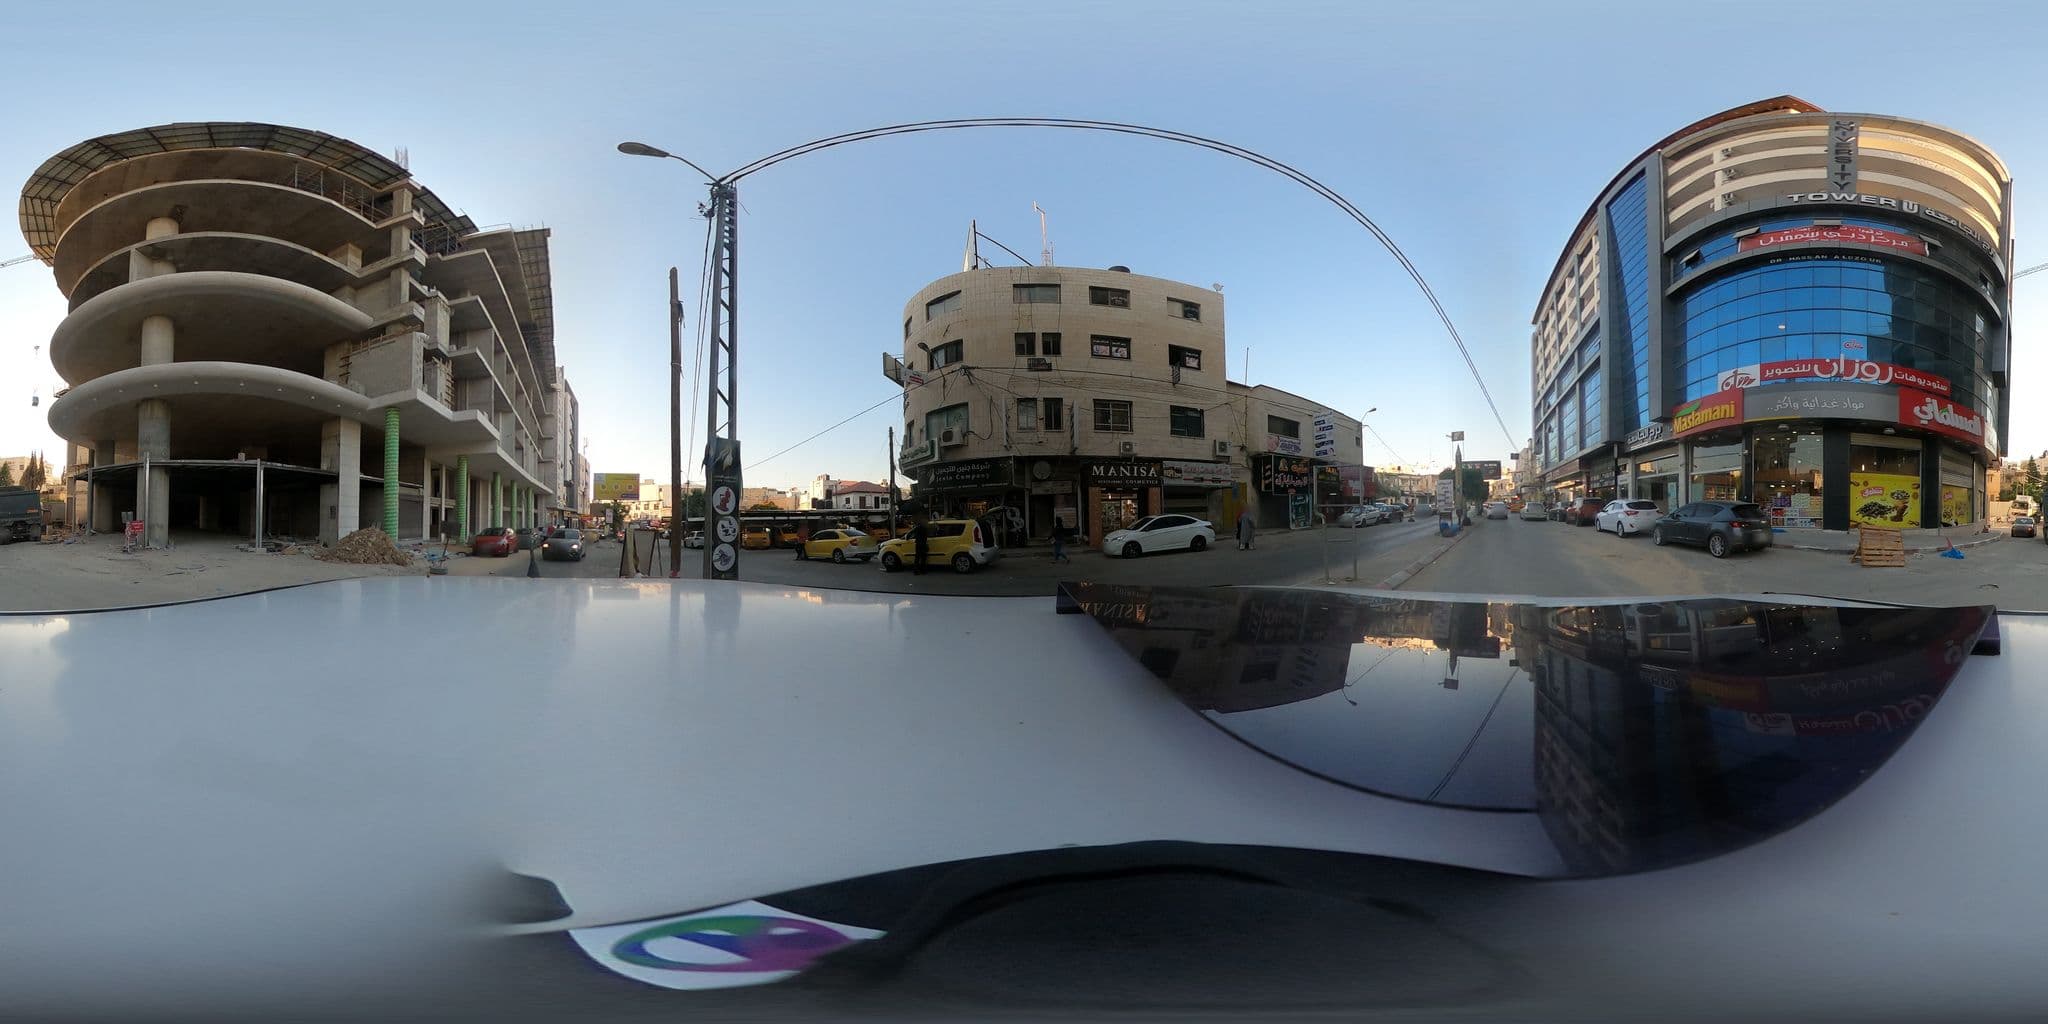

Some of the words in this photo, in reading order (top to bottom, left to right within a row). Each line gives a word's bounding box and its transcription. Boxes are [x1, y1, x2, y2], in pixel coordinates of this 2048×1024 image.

[1787, 192, 1897, 207] TOWER
[1764, 363, 1811, 377] للتصوير
[1813, 353, 1894, 385] روزان
[1894, 370, 1948, 391] ستوديوهات
[1842, 397, 1865, 410] مواد
[1673, 400, 1735, 433] Maslamani
[1649, 425, 1663, 441] برج
[1092, 465, 1158, 477] MANISA
